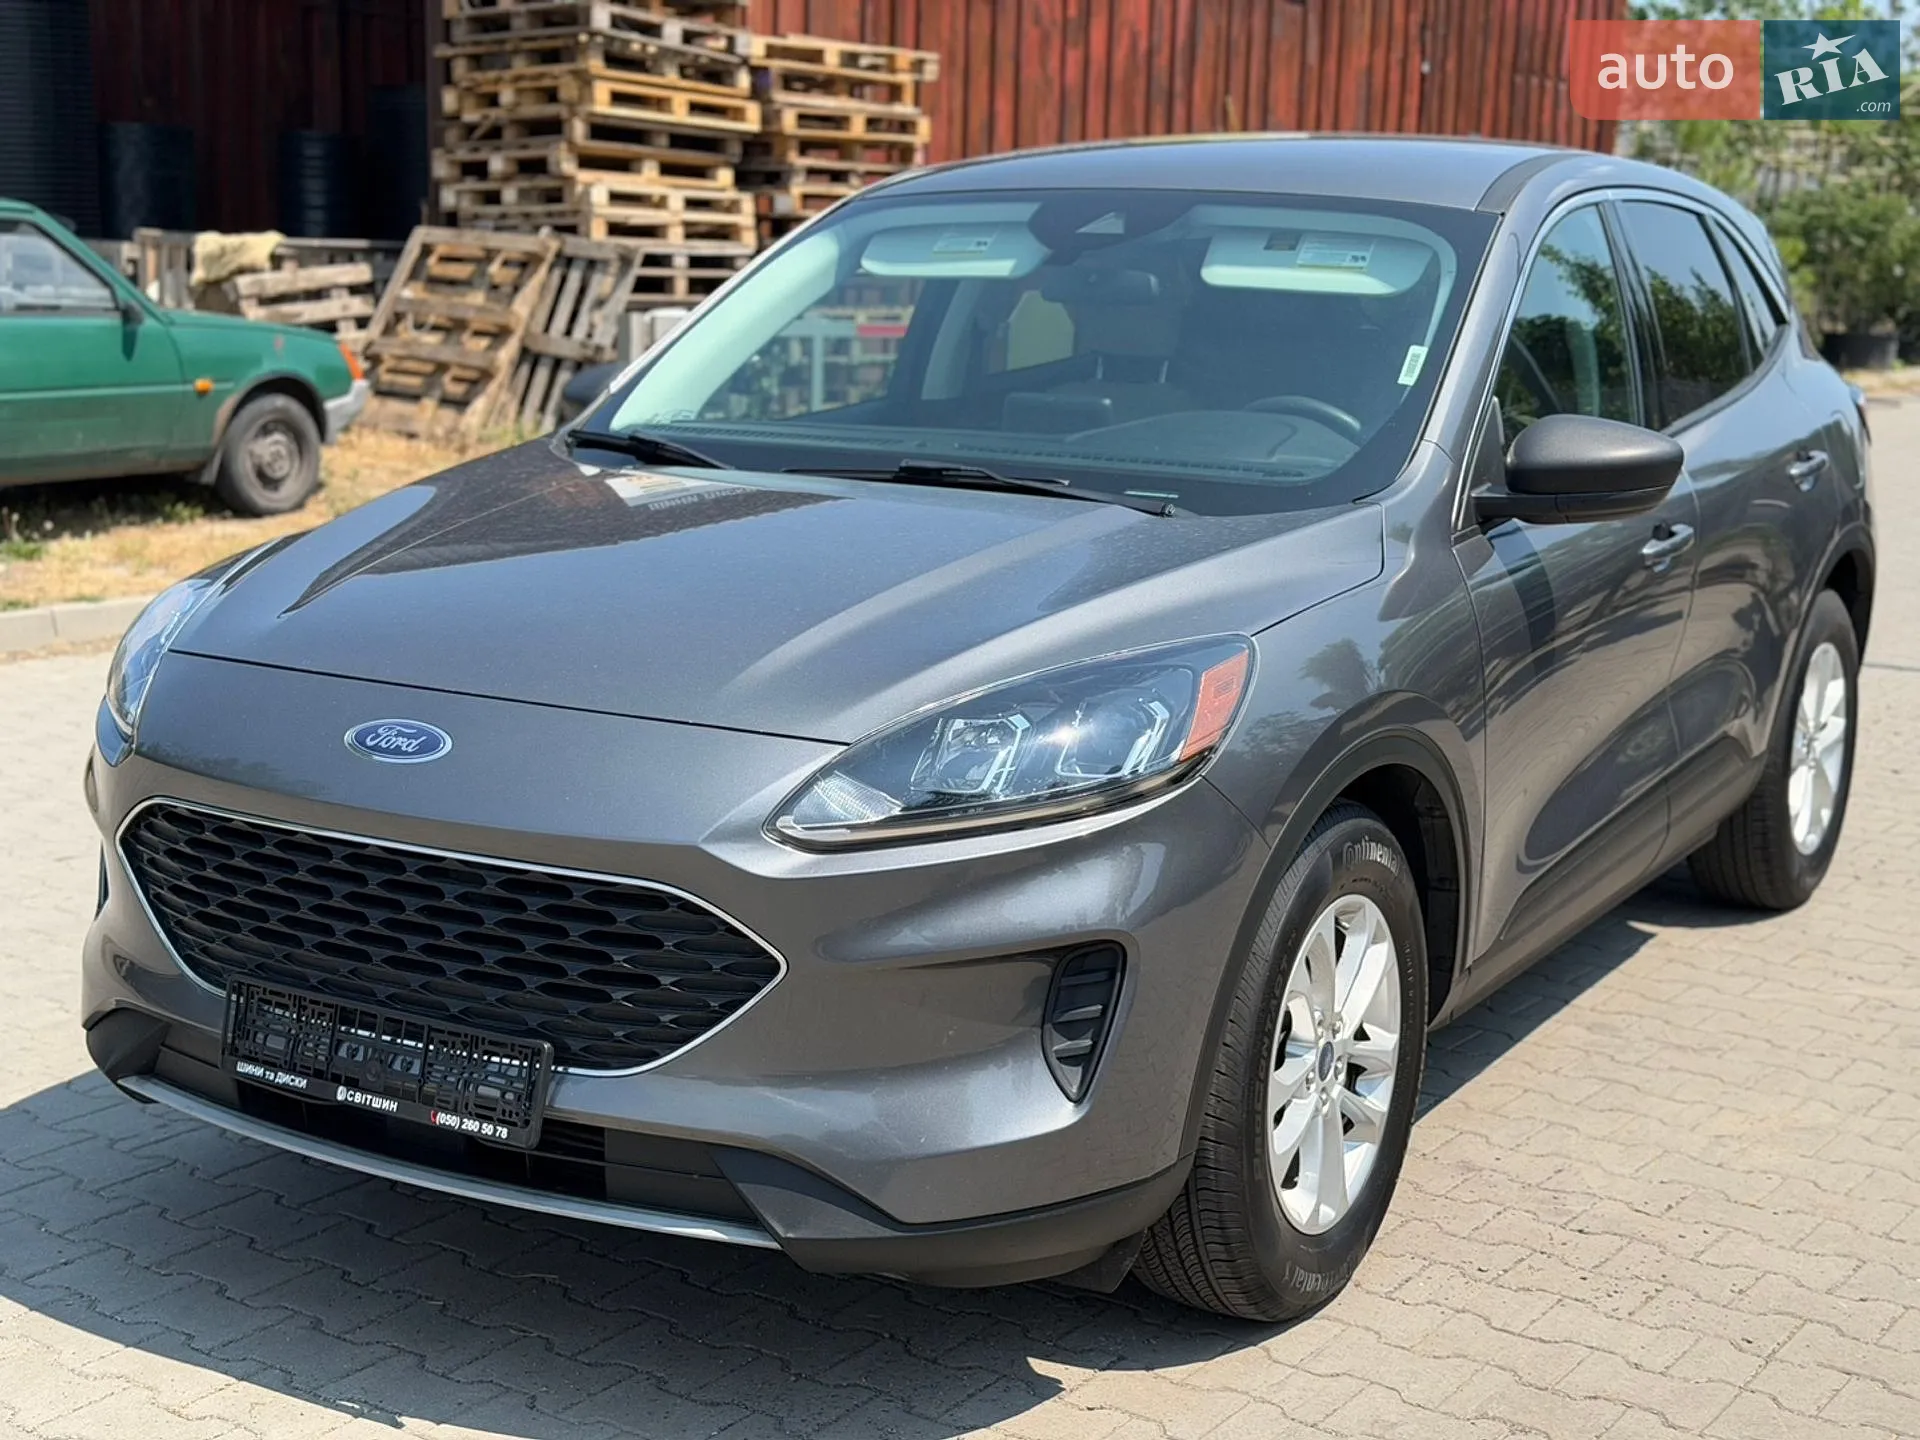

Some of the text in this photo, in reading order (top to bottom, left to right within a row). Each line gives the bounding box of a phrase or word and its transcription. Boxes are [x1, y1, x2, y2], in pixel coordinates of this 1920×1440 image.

[365, 724, 428, 752] Ford
[236, 1061, 308, 1089] ШИНИ та ДИСКИ
[346, 1089, 399, 1112] СВІТШИН
[436, 1111, 508, 1139] (050) 260 50 78
